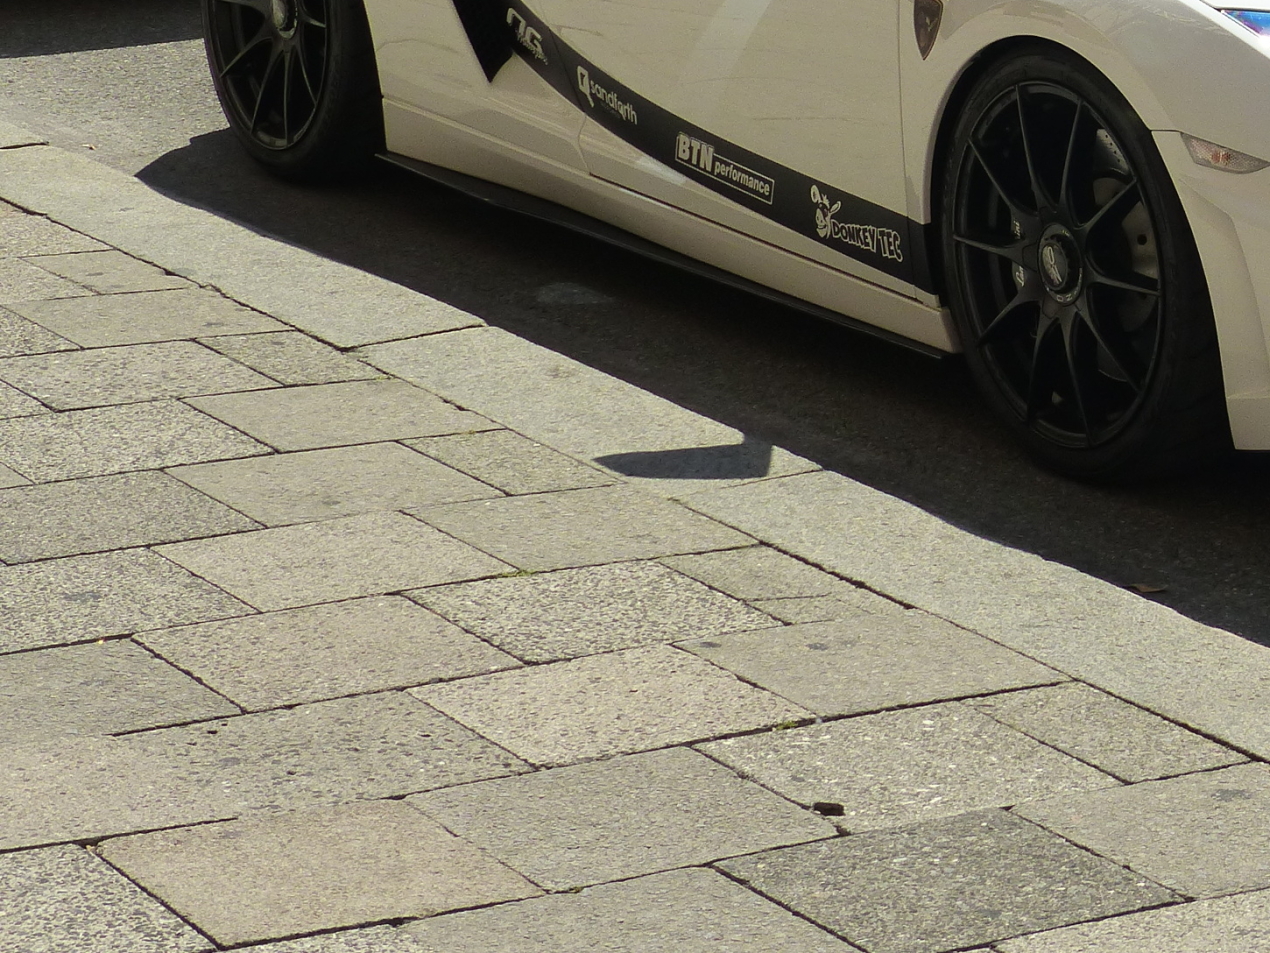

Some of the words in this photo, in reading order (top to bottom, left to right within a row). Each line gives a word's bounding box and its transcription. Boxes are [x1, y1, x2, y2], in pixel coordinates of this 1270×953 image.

[678, 131, 714, 173] BTN
[714, 160, 771, 197] performance
[831, 218, 877, 254] DONKEY
[876, 227, 904, 264] TEC
